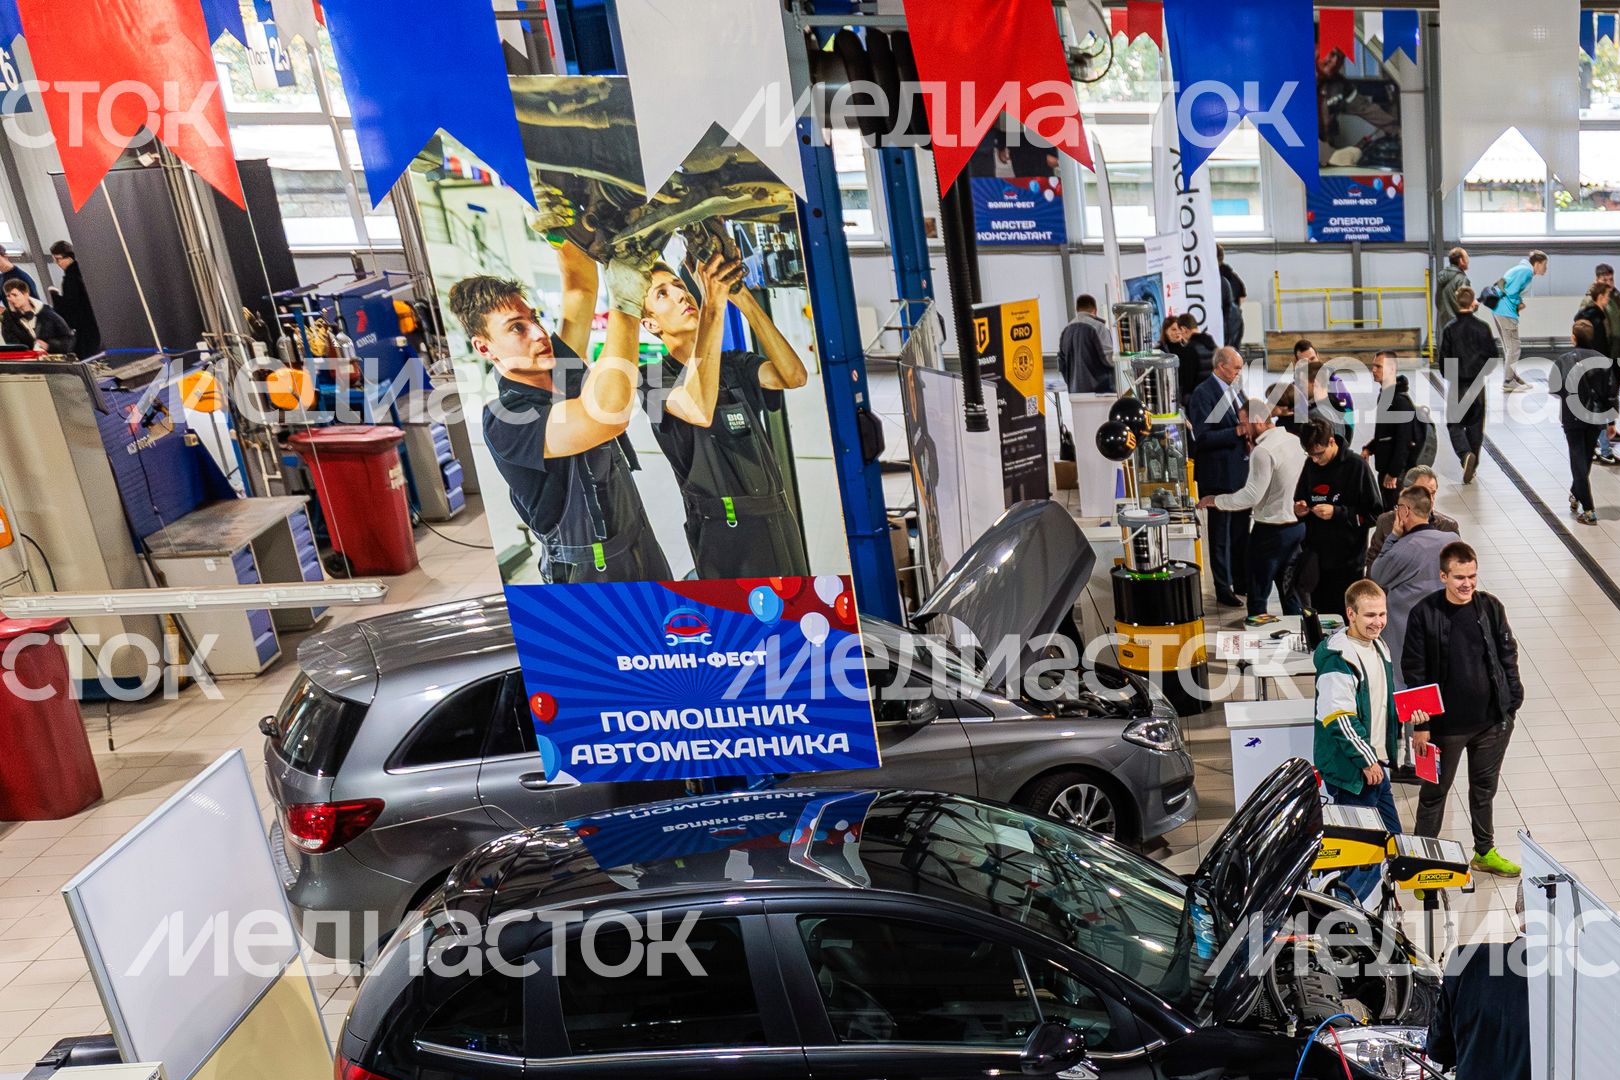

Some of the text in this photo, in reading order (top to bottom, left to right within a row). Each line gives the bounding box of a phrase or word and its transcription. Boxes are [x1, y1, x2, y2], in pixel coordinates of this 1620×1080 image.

[991, 220, 1036, 229] МАСТЕР
[1329, 217, 1384, 226] ОПЕРАТОР
[976, 231, 1052, 241] КОНСУЛЬТАНТ
[1013, 325, 1031, 341] PRO
[617, 650, 767, 672] ВОЛИН-ФЕСТ
[600, 703, 810, 733] ПОМОЩНИК
[571, 732, 850, 766] АВТОМЕХАНИКА
